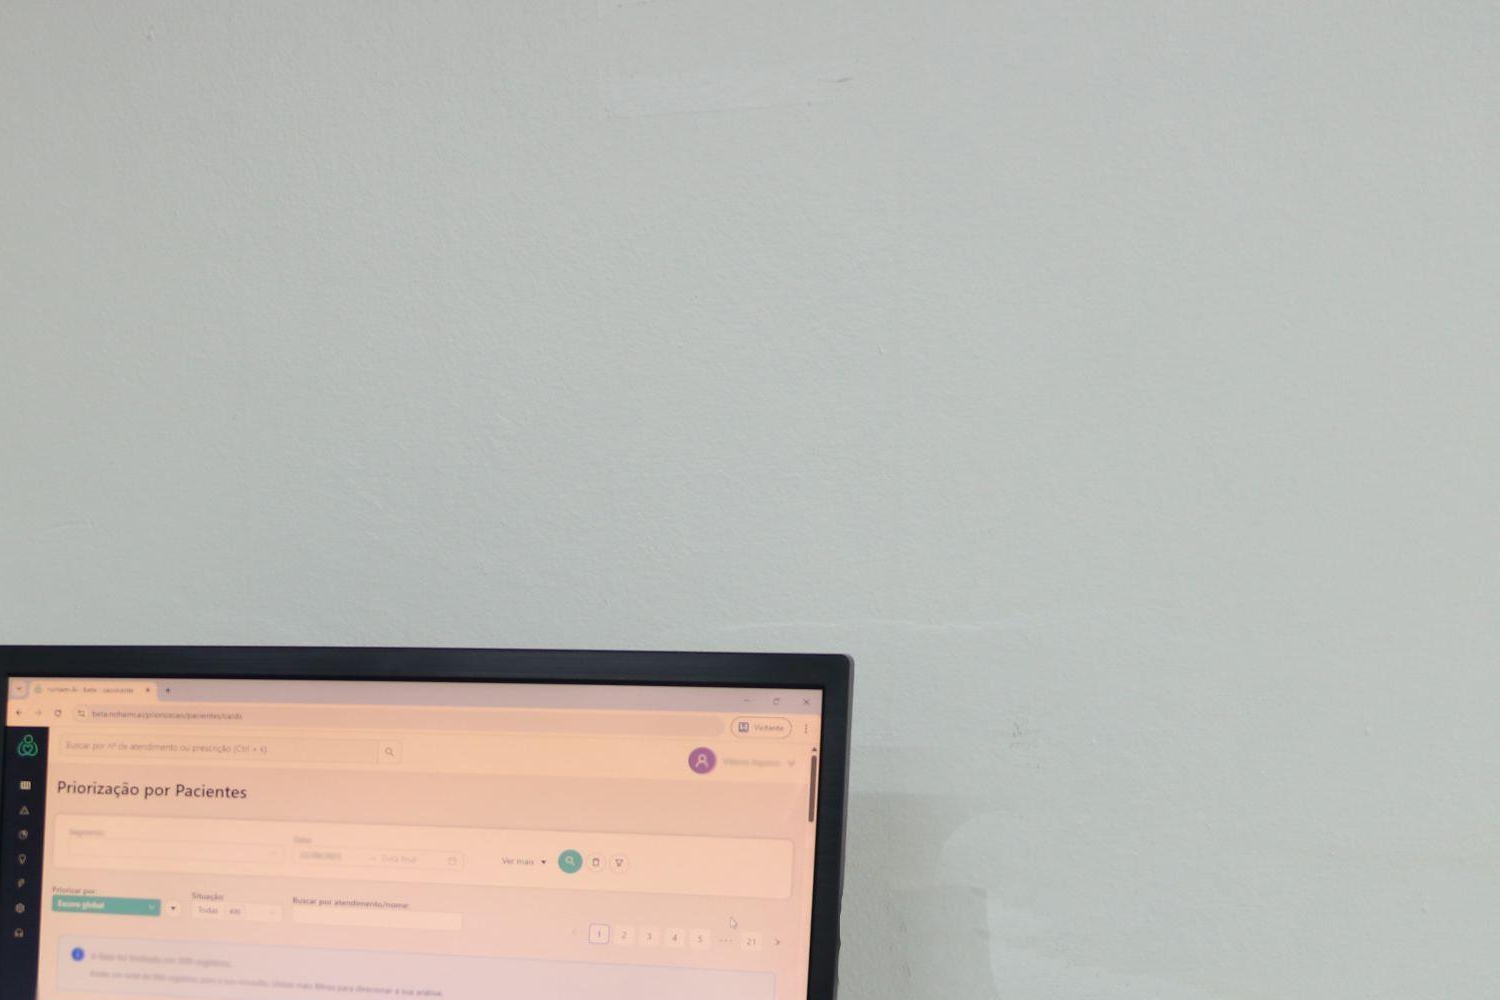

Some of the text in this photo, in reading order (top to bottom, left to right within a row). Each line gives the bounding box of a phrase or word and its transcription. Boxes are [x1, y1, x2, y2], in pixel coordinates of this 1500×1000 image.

[92, 743, 106, 752] por
[119, 742, 128, 751] de
[57, 780, 248, 799] Priorização por Pacientes
[501, 857, 535, 866] Ver mais
